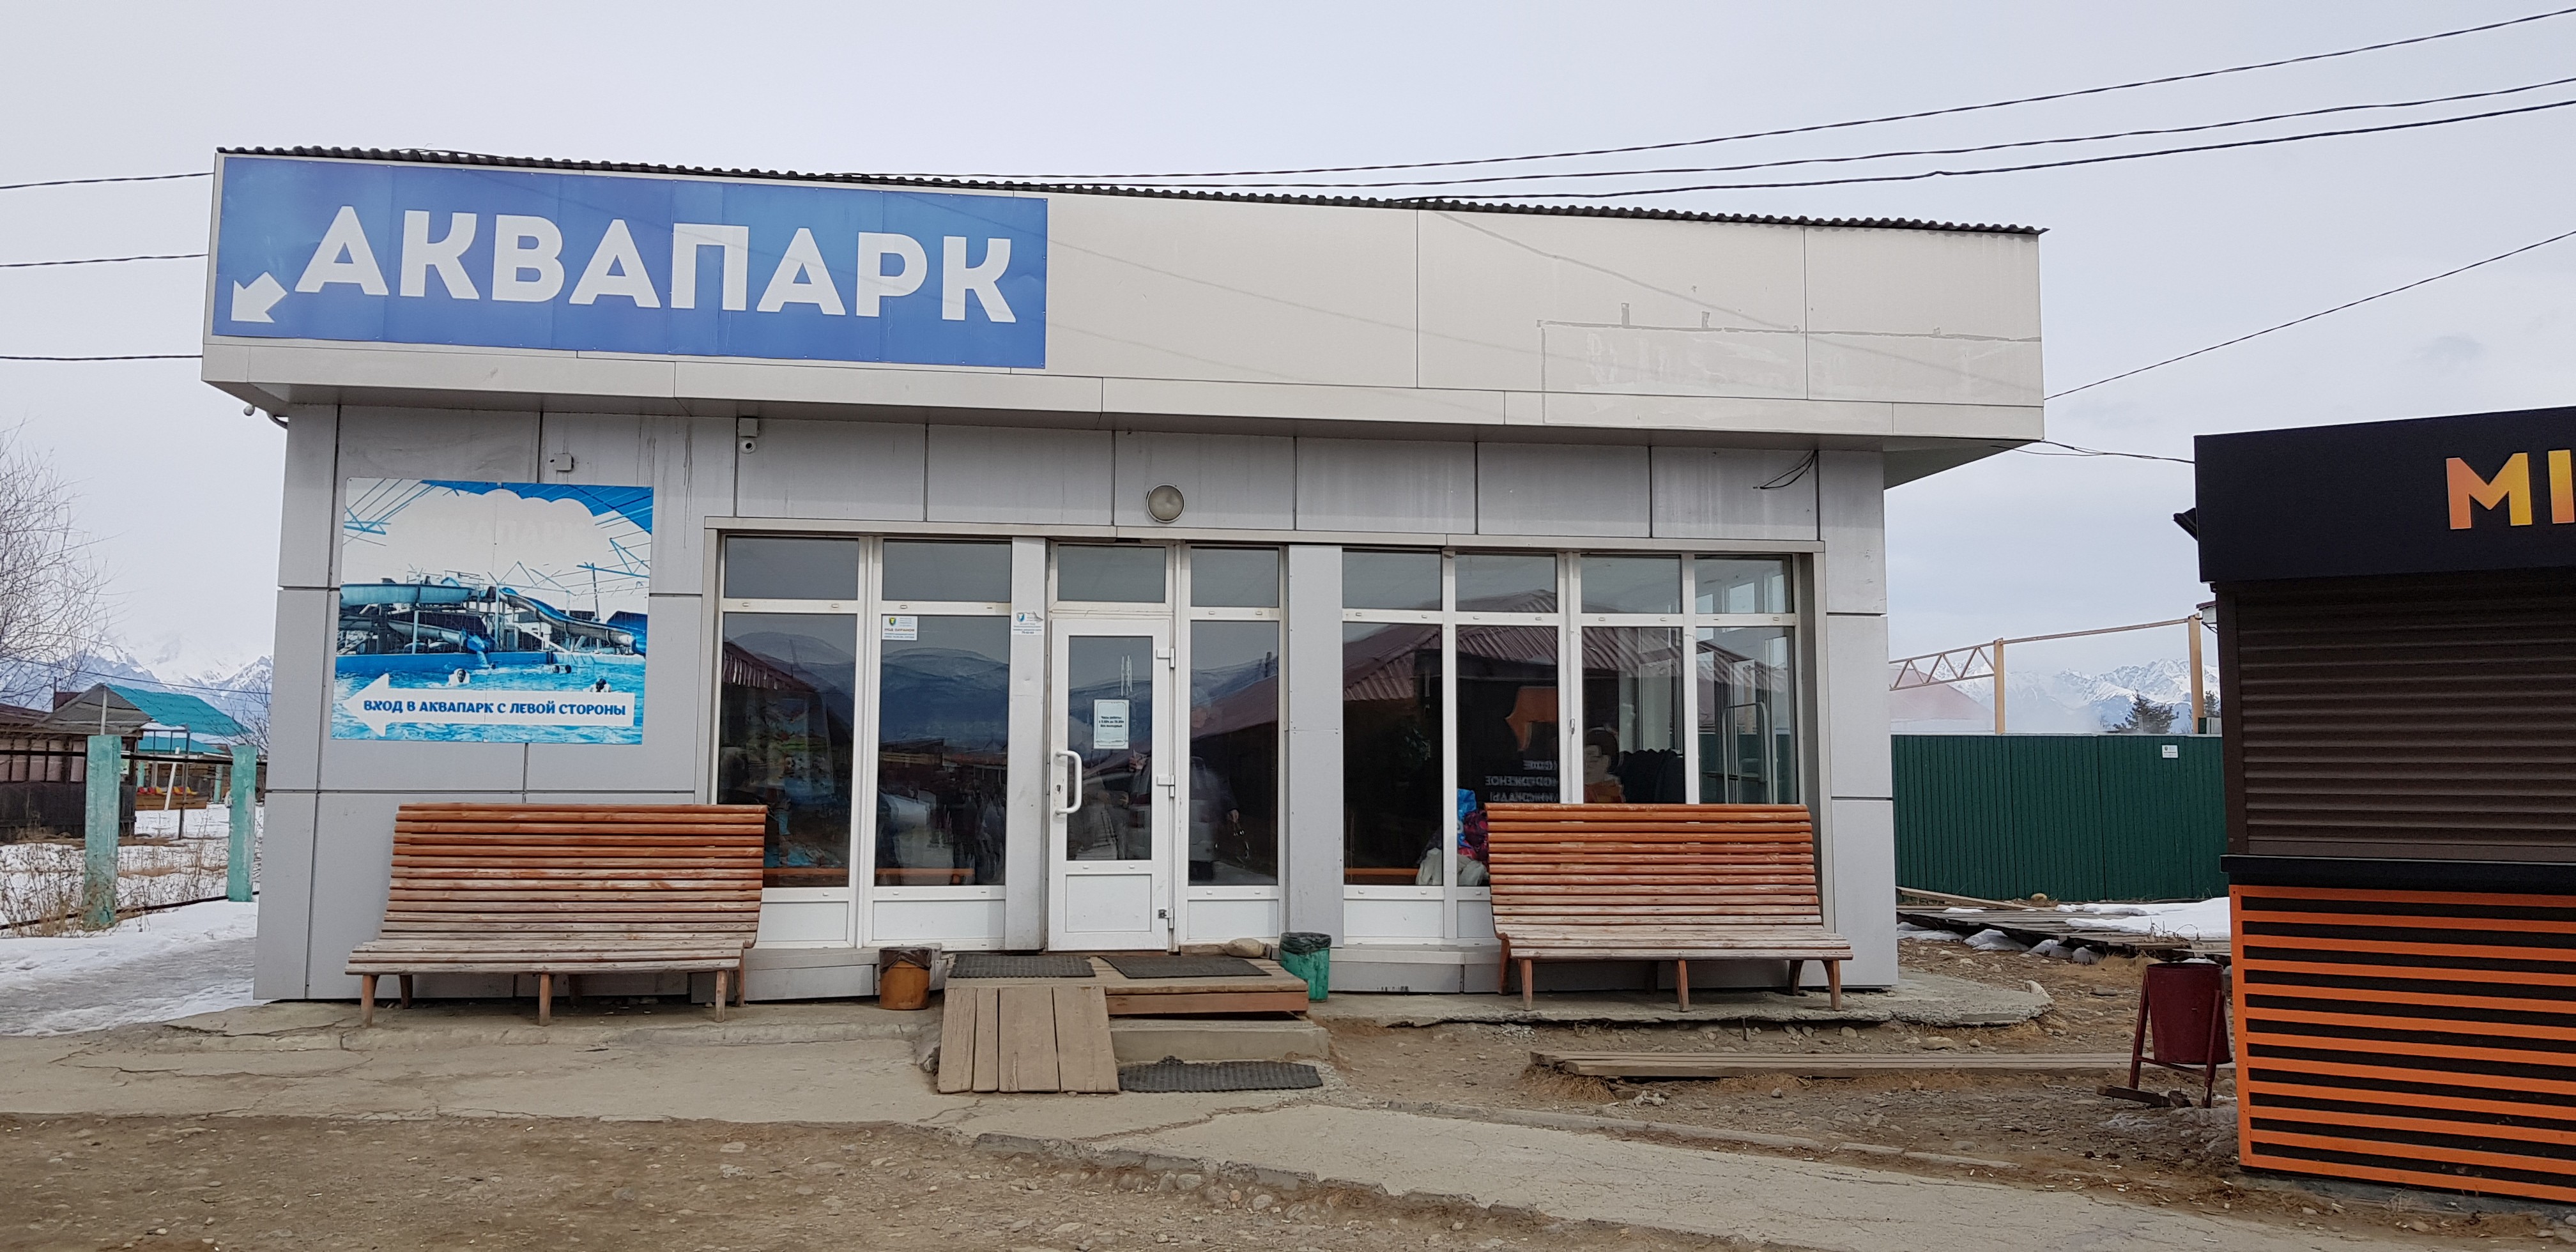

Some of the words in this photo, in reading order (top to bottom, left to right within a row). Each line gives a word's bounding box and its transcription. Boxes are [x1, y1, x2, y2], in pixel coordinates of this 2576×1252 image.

[295, 206, 1016, 322] АКВАПАРК
[364, 700, 403, 714] ВХОД
[407, 701, 415, 712] В
[418, 701, 494, 714] АКВАПАРК
[497, 703, 506, 713] С
[509, 700, 556, 714] ЛЕВОЙ
[558, 704, 626, 715] СТОРОНЫ
